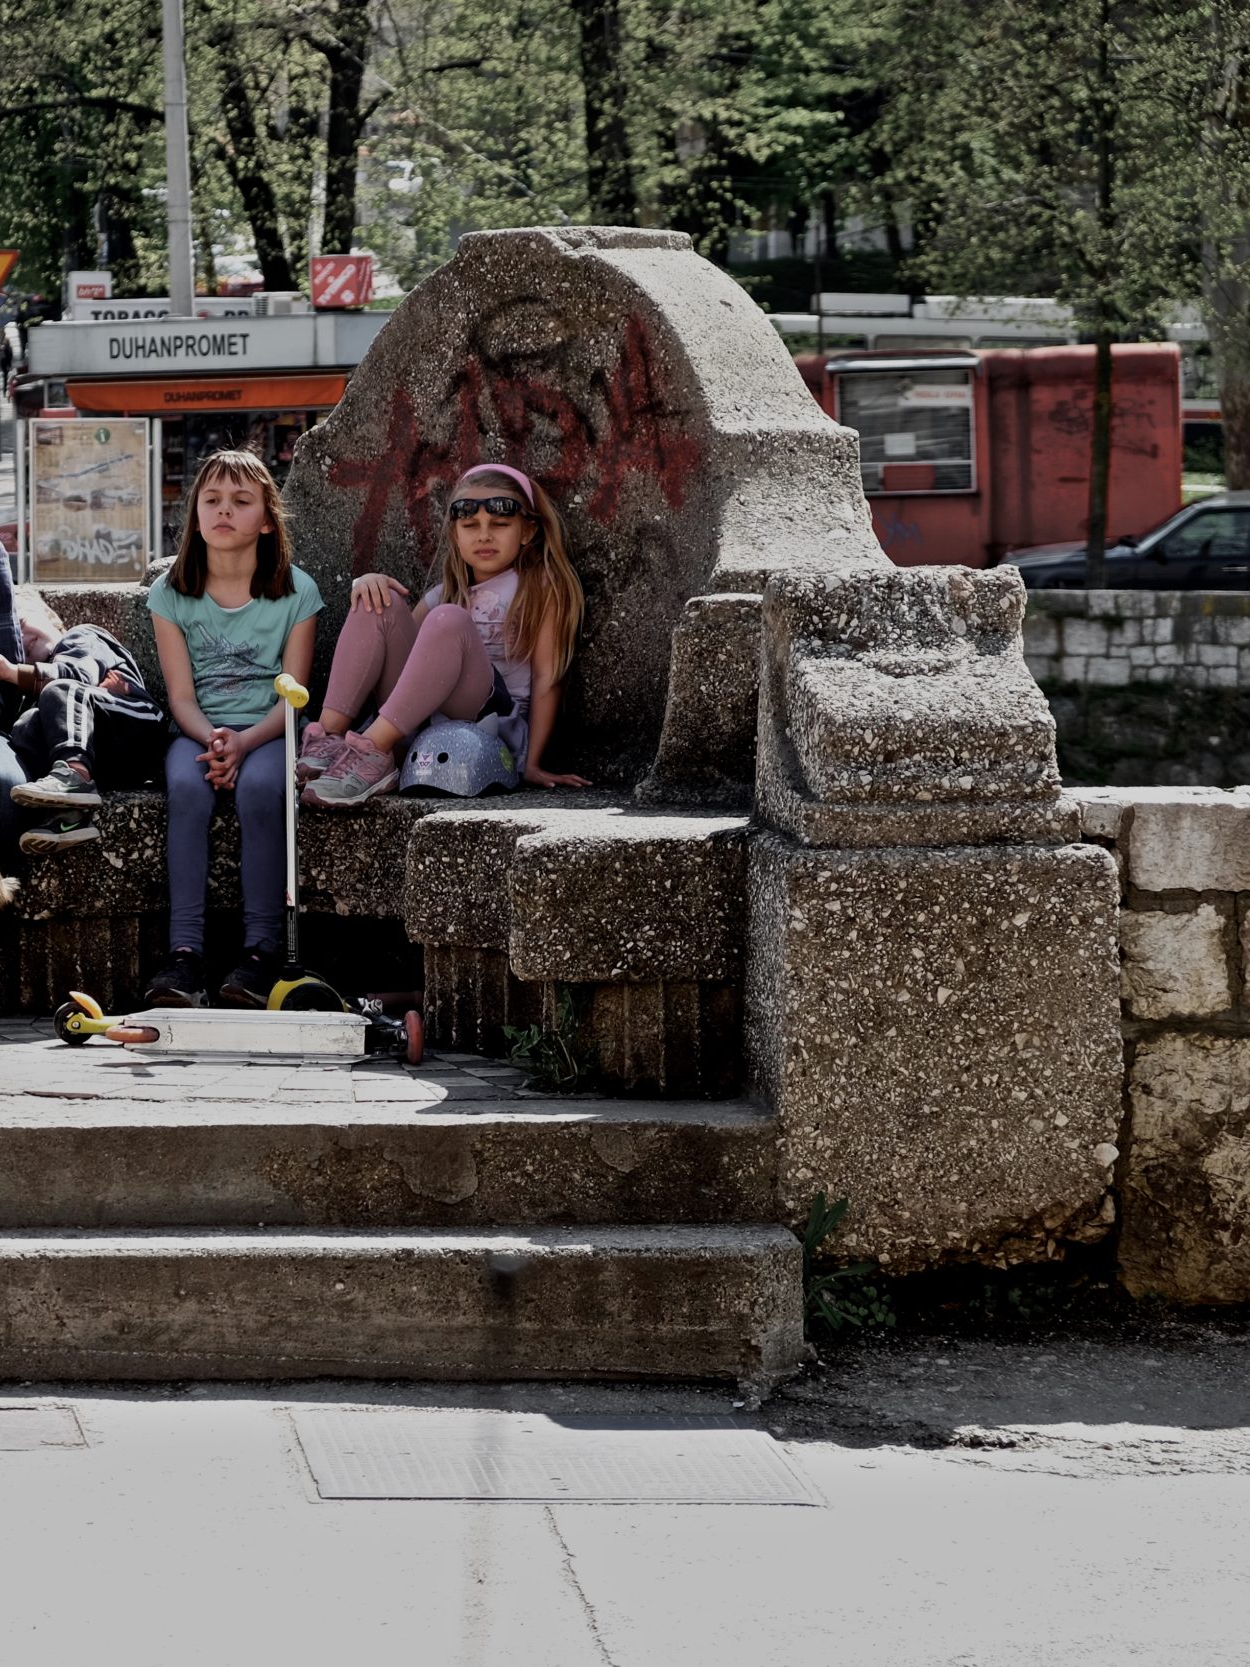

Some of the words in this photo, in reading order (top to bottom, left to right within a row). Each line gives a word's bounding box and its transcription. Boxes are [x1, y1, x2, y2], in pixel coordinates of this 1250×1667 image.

[90, 309, 170, 321] TOBACC
[109, 333, 250, 359] DUHANPROMET
[163, 389, 243, 403] DUHANPROMET
